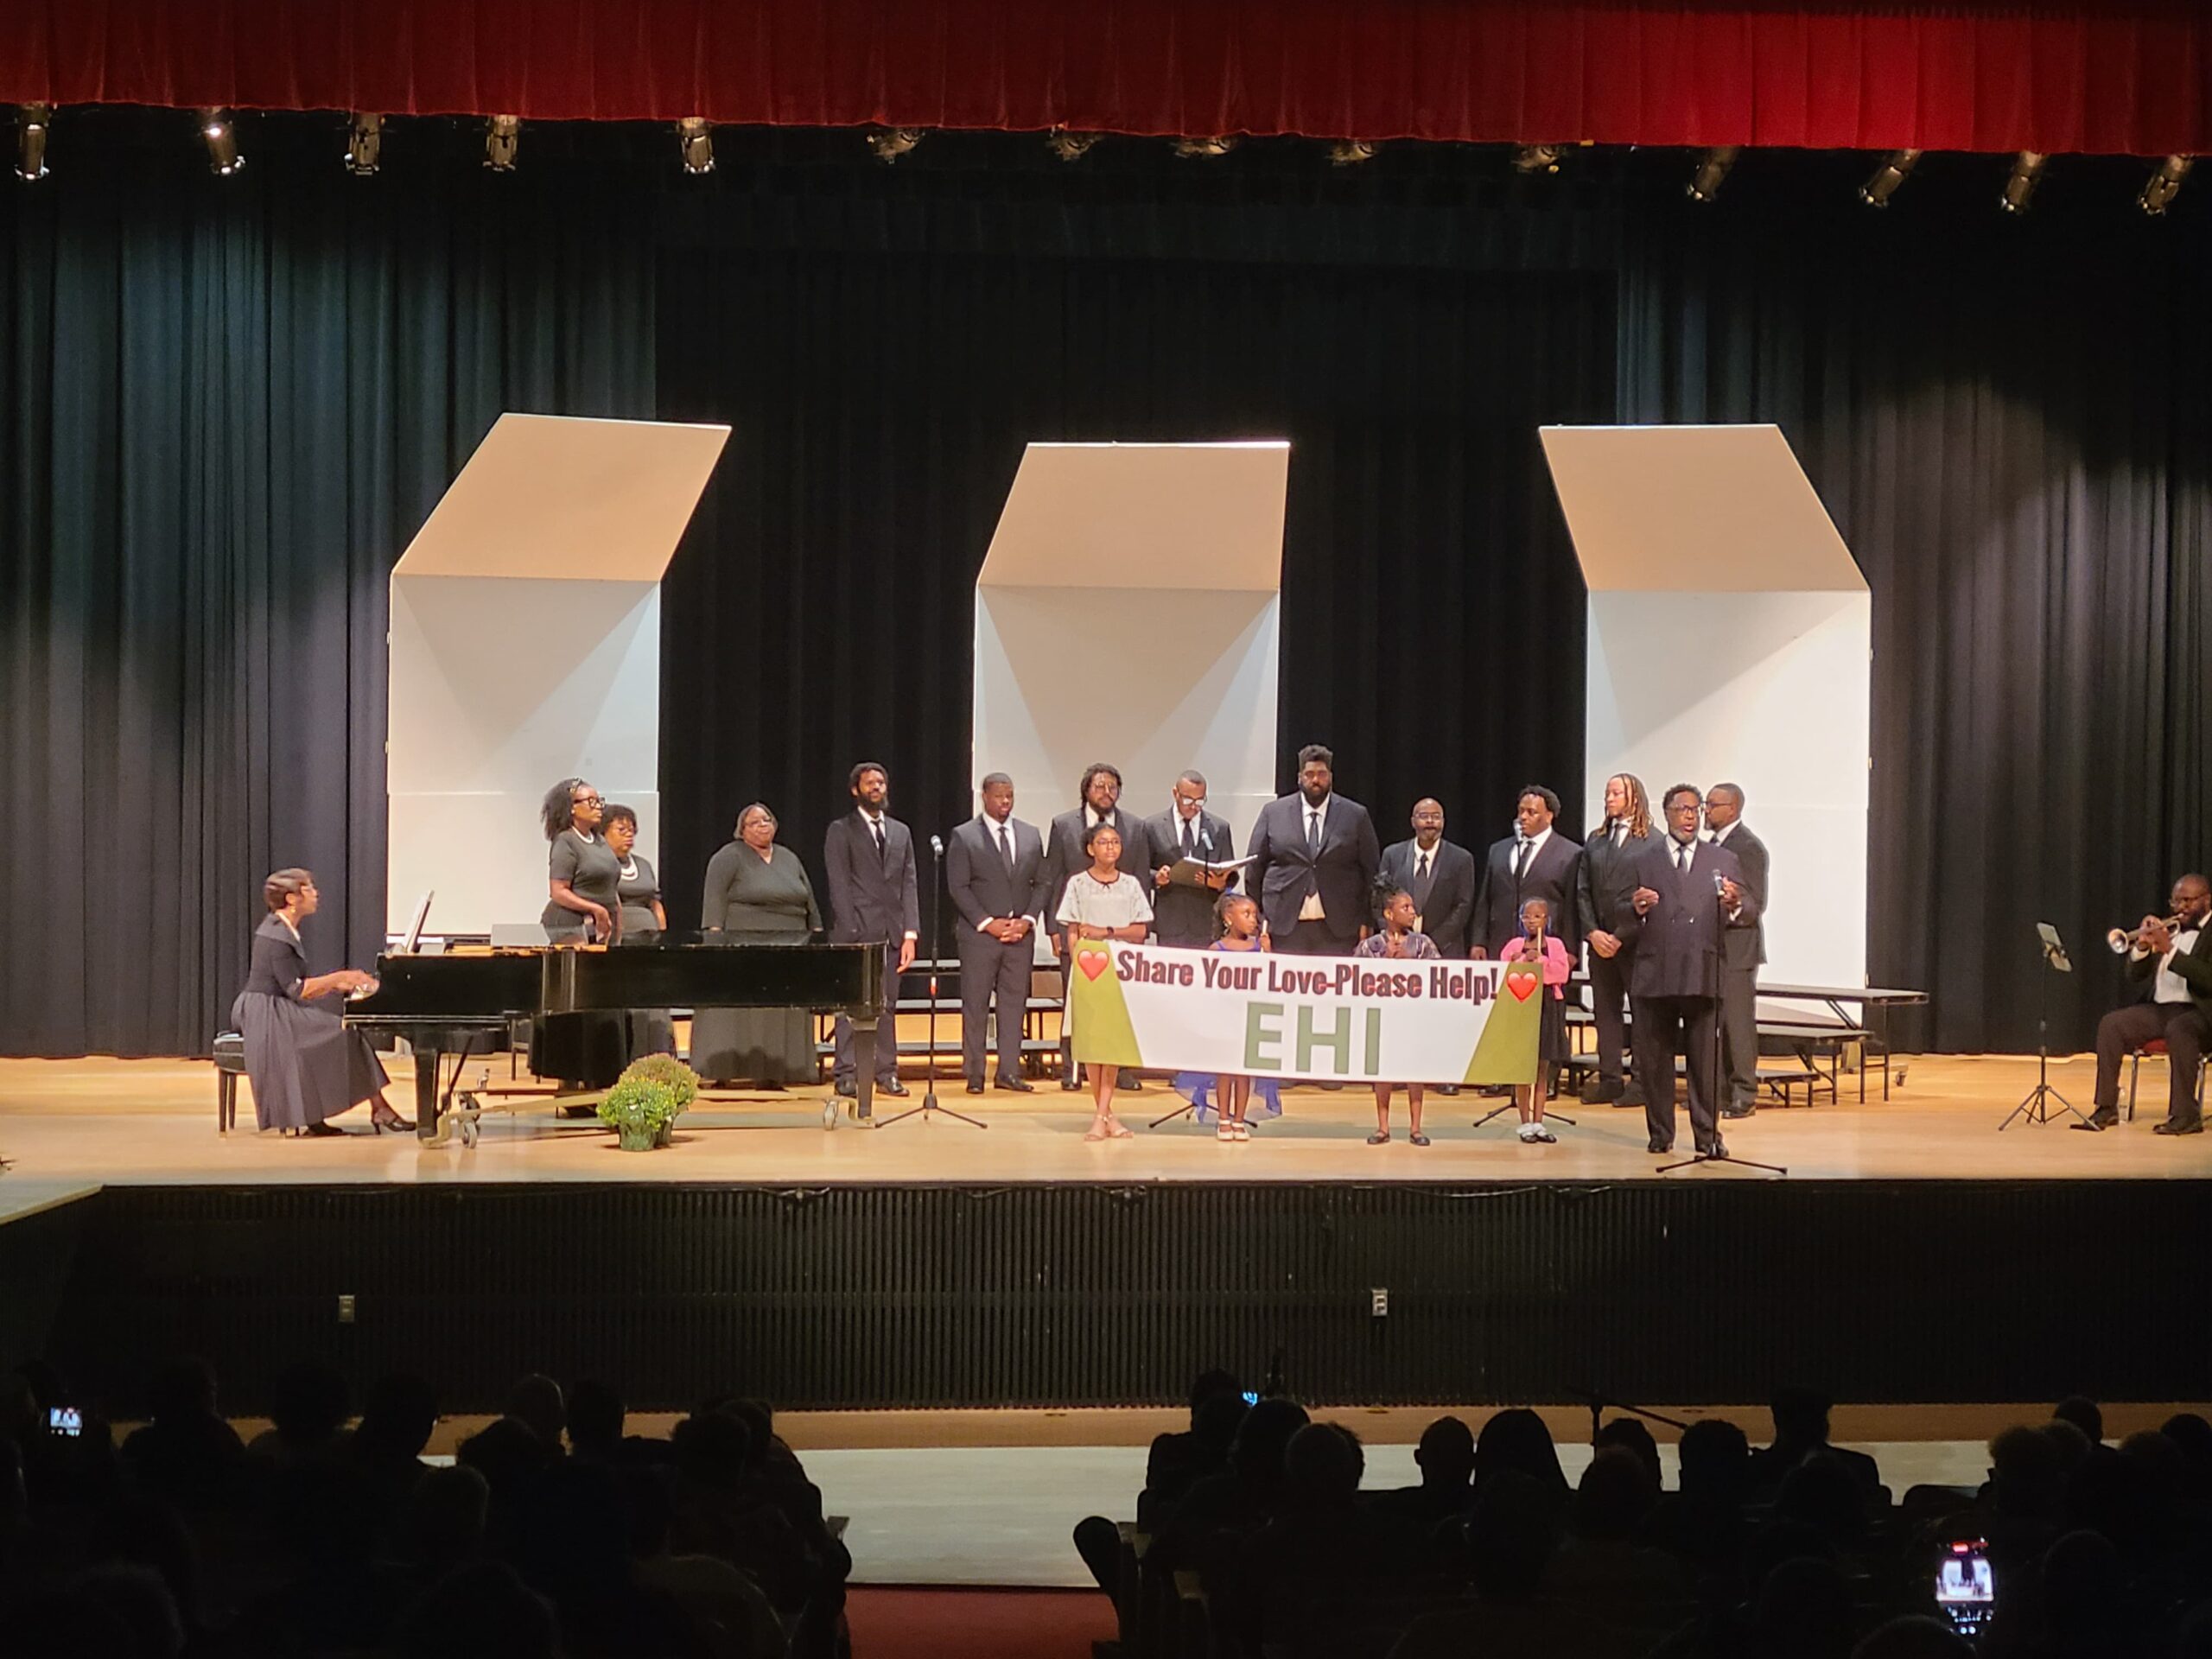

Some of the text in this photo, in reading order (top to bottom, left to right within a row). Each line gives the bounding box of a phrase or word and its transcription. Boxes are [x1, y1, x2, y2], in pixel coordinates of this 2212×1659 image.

[1116, 950, 1194, 987] Share
[1202, 957, 1262, 990] Your
[1430, 967, 1498, 1006] Help!
[1243, 1001, 1381, 1075] EHI
